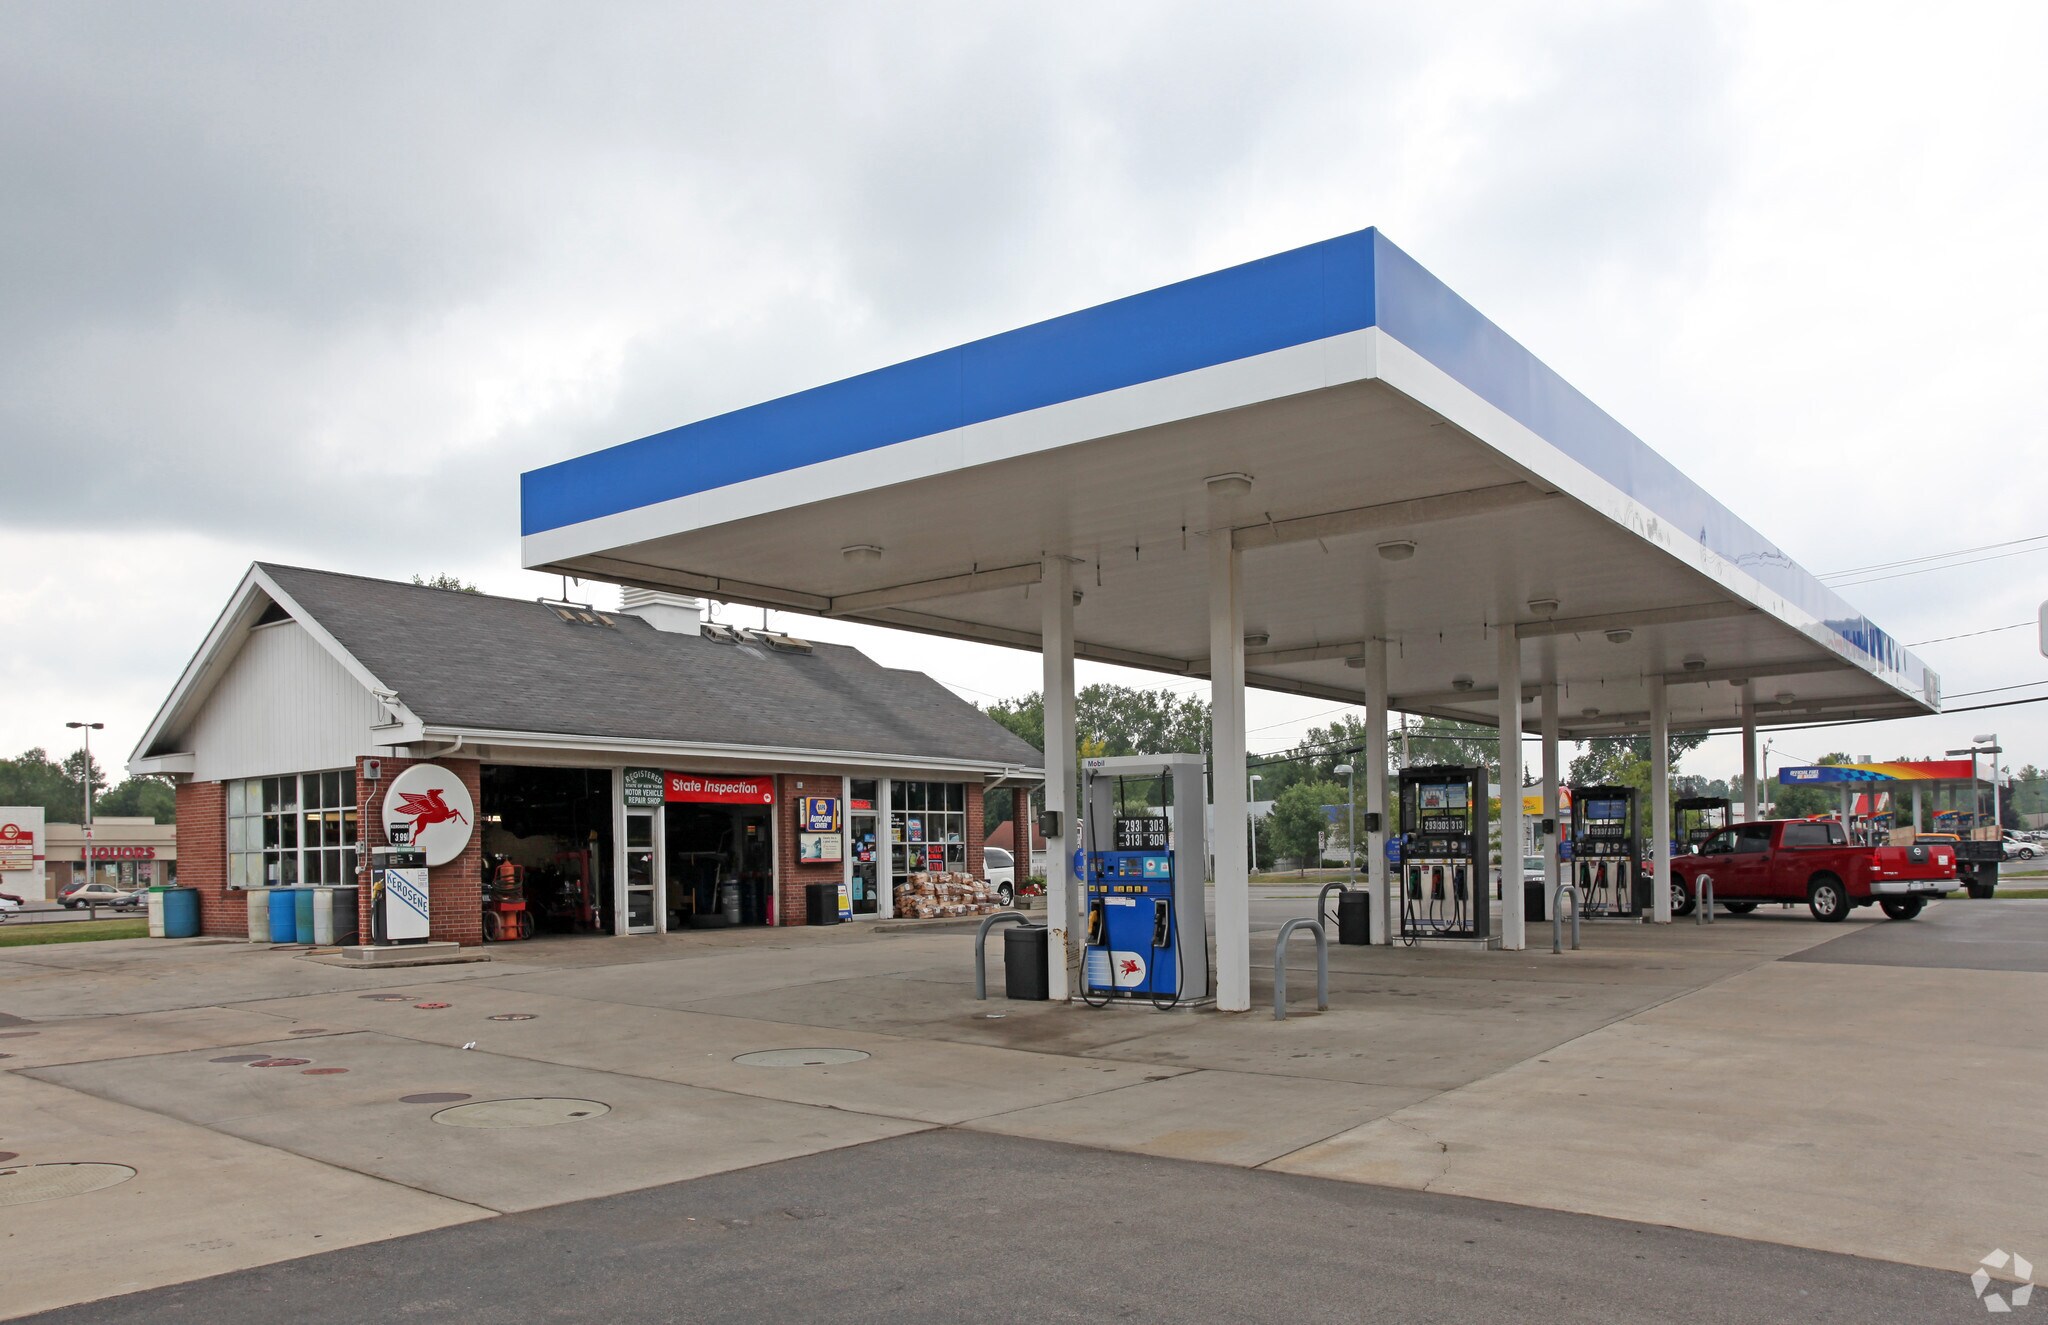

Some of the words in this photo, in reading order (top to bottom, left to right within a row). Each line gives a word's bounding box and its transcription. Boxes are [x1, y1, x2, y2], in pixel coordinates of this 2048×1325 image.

[624, 770, 663, 784] REGISTERED
[624, 788, 642, 796] MOTOR
[643, 789, 664, 797] VEHICLE
[672, 778, 701, 791] State
[704, 780, 758, 795] Inspection
[628, 796, 646, 804] REPAIR
[647, 797, 661, 805] SHOP
[1125, 820, 1140, 832] 293
[1149, 819, 1164, 832] 303
[1425, 821, 1437, 830] 293
[1437, 821, 1449, 830] 303
[1451, 820, 1463, 830] 313
[1125, 834, 1140, 846] 313
[1149, 833, 1164, 846] 309
[387, 873, 428, 912] KEROSENE
